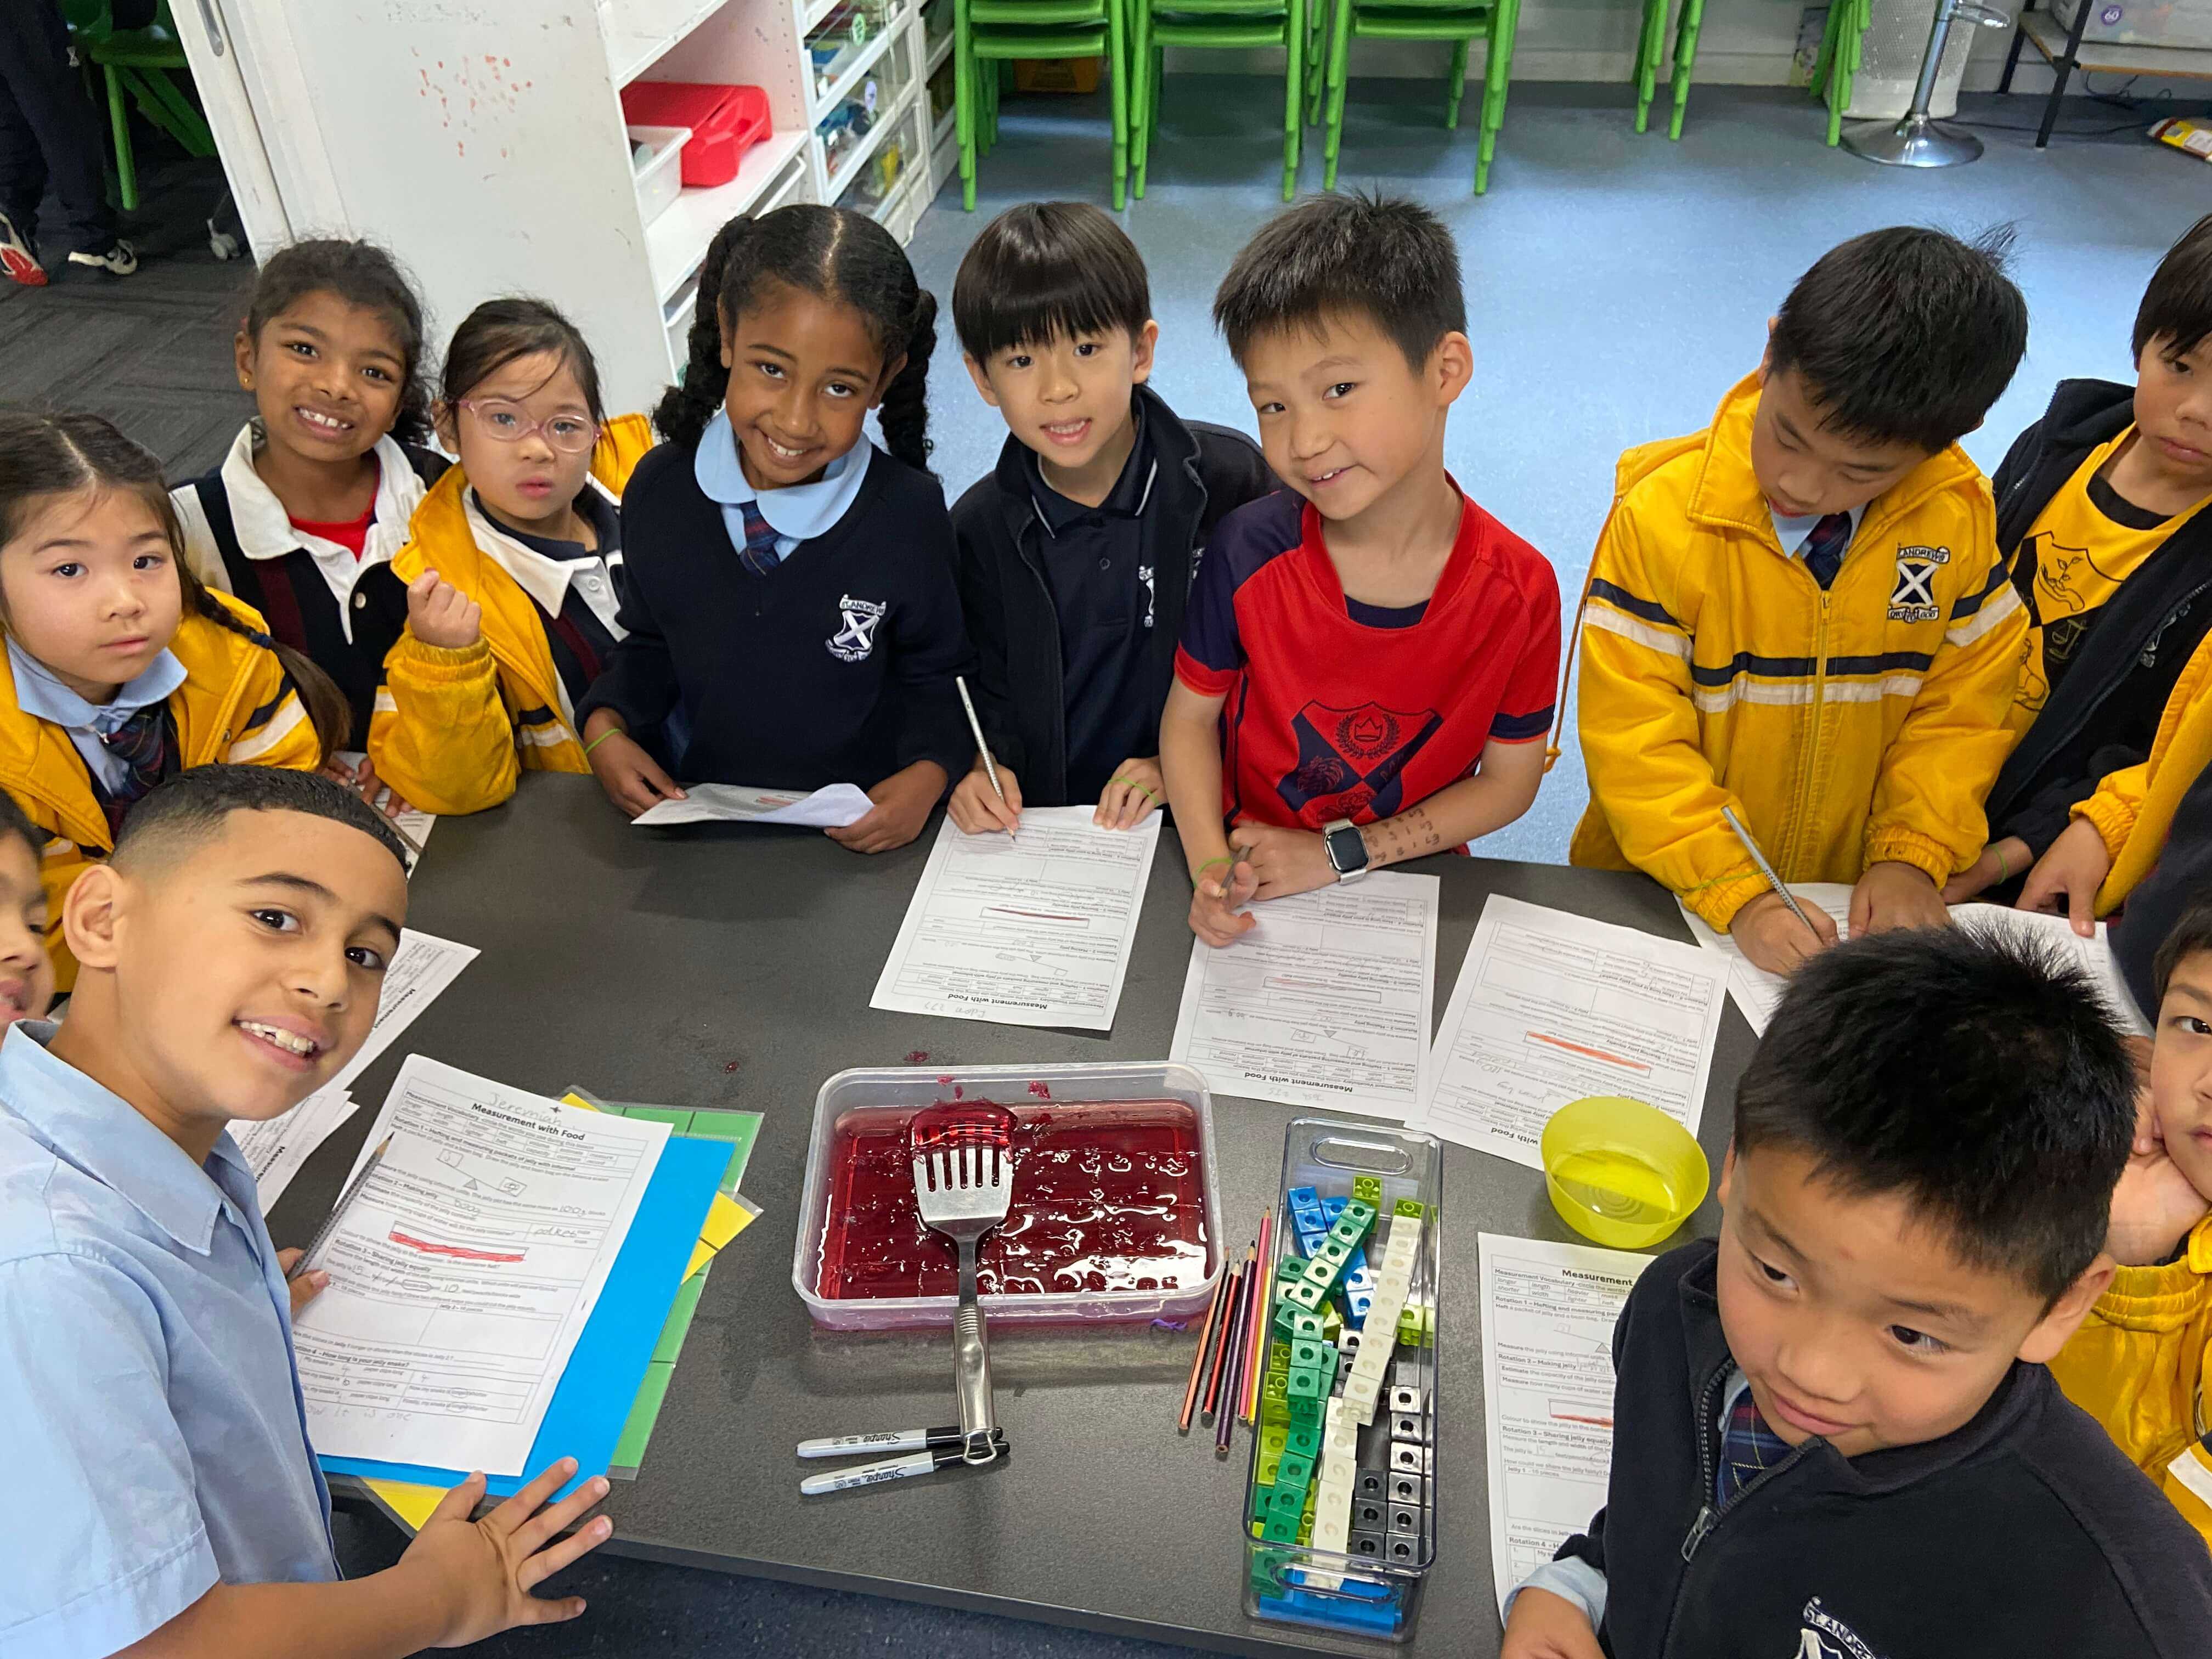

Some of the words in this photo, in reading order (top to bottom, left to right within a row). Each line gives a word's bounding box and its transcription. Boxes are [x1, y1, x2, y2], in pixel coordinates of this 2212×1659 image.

[991, 999, 1047, 1009] Measurement
[1244, 1071, 1266, 1080] Food
[1269, 1075, 1289, 1084] with
[1291, 1078, 1352, 1092] Measurement
[489, 1092, 562, 1126] Jeremiah
[471, 1103, 535, 1129] Measurement
[538, 1125, 558, 1135] with
[561, 1130, 585, 1141] Food
[1489, 1127, 1515, 1138] Food
[1516, 1134, 1538, 1144] with
[1494, 1268, 1538, 1280] Measurement
[1539, 1276, 1575, 1287] Vocabulary
[1497, 1277, 1516, 1285] longer
[1562, 1268, 1633, 1286] Measurement
[1498, 1285, 1519, 1293] shorter
[1531, 1282, 1550, 1290] length
[1567, 1288, 1589, 1296] heavier
[1495, 1295, 1522, 1305] Rotation
[1533, 1301, 1556, 1311] Hefting
[1571, 1307, 1605, 1317] measuring
[1498, 1353, 1525, 1363] Rotation
[1537, 1359, 1561, 1368] Making
[1502, 1426, 1531, 1435] Rotation
[1543, 1431, 1569, 1441] Sharing
[1586, 1437, 1611, 1446] equally
[865, 1468, 906, 1482] Sharpie
[1509, 1537, 1539, 1546] Rotation
